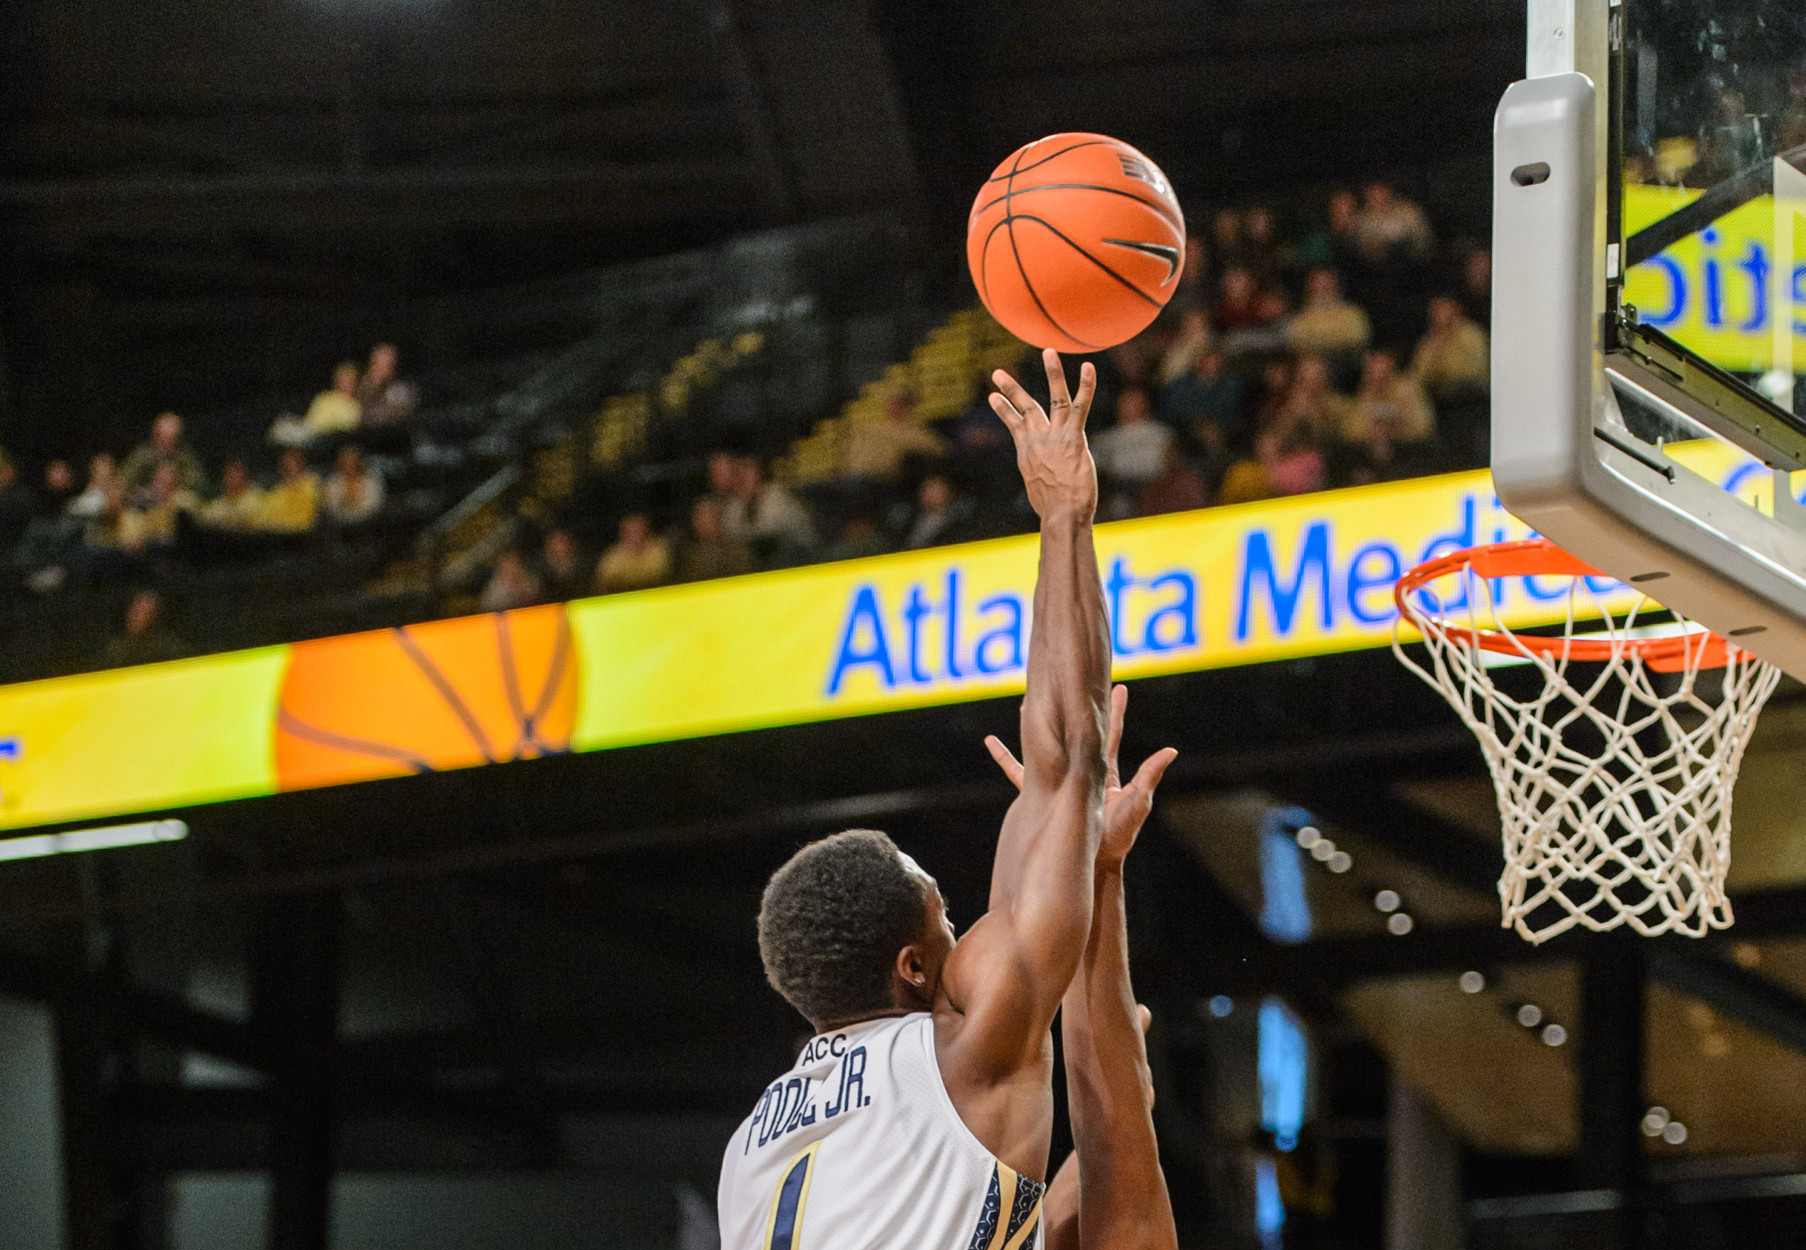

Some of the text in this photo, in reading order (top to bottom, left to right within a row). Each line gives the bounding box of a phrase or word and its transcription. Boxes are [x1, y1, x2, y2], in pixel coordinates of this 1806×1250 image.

[826, 555, 1197, 696] Atlata
[801, 1033, 847, 1067] ACC
[824, 1045, 871, 1119] JR.
